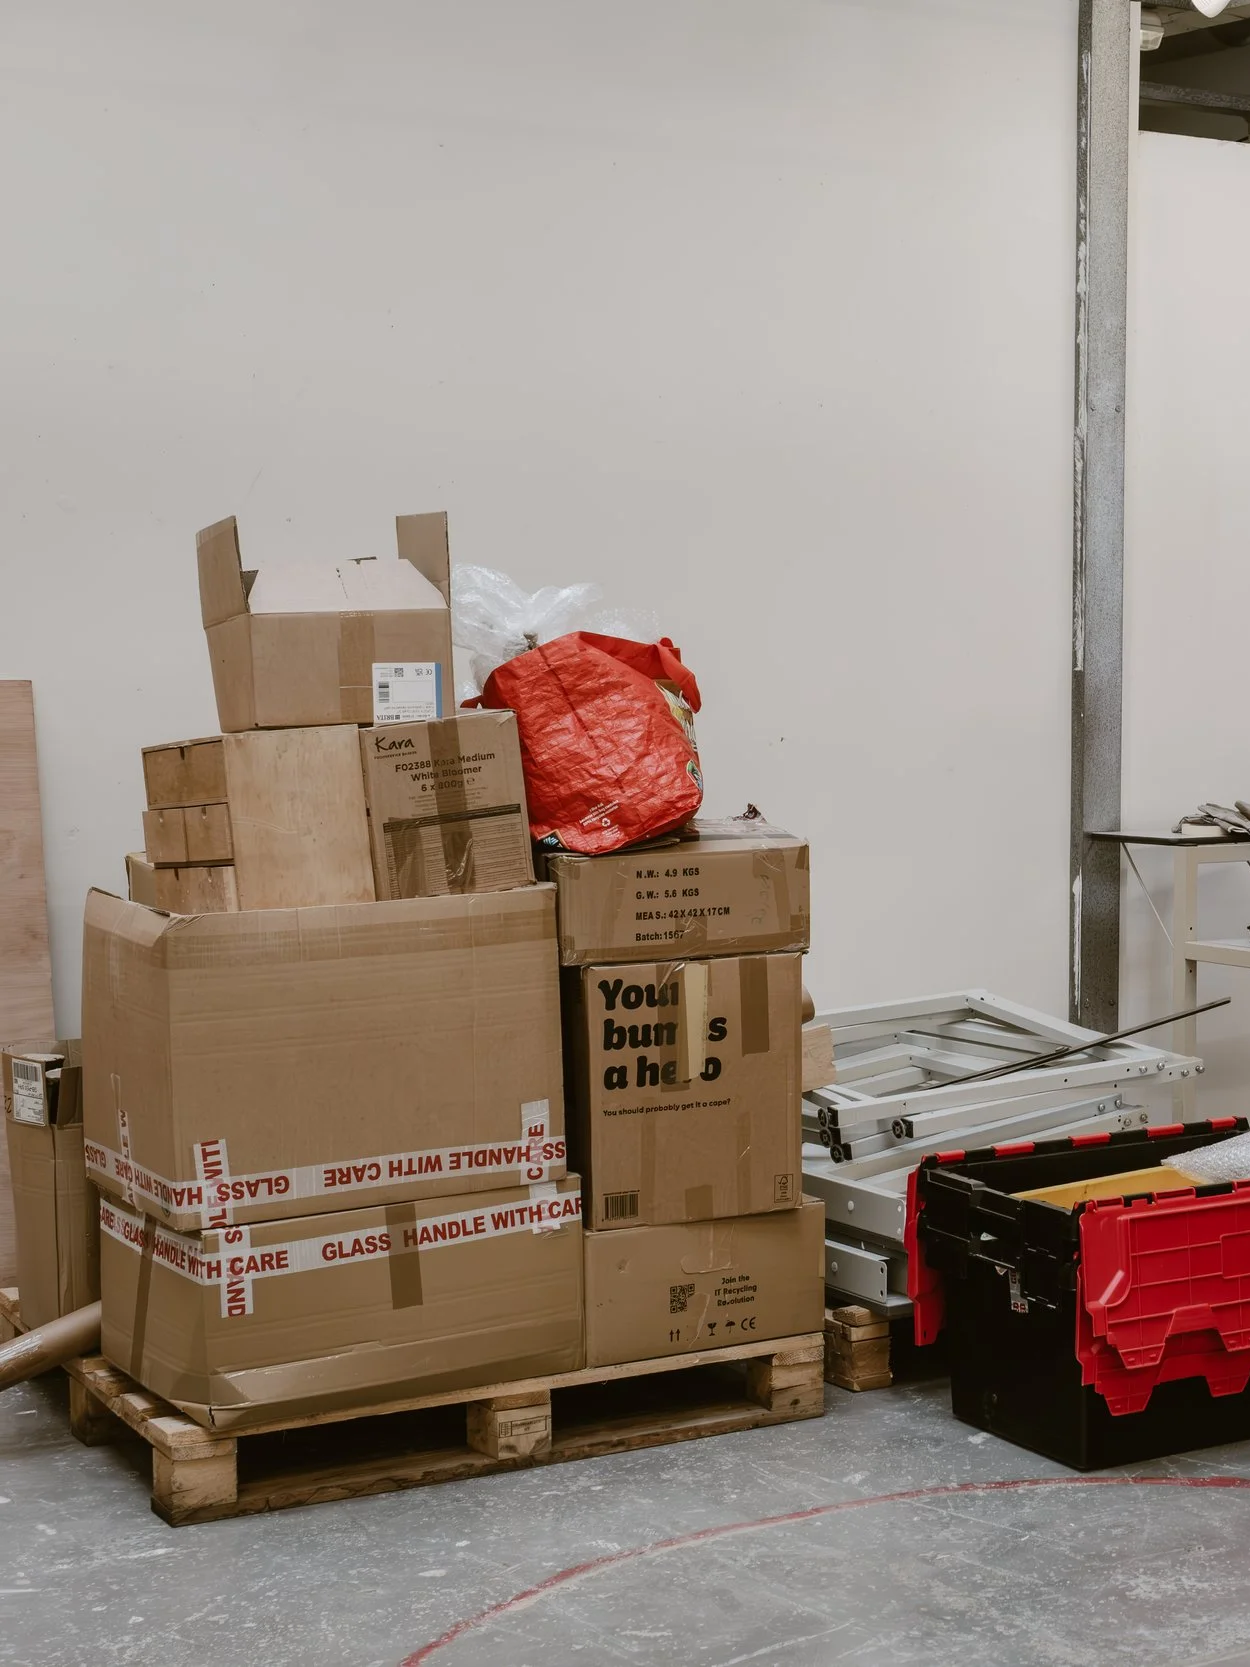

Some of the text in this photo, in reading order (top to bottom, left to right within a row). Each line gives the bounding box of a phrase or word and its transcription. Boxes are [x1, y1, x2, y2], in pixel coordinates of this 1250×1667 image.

[374, 736, 415, 753] Kara
[433, 757, 455, 768] Kara
[458, 751, 496, 764] Medium
[410, 765, 482, 782] White Bloomer
[421, 782, 428, 792] 6
[430, 783, 436, 791] x
[664, 868, 678, 878] 4.9
[682, 867, 700, 876] KGS
[664, 889, 677, 898] 5.6
[682, 888, 700, 897] KGS
[604, 1055, 722, 1090] a heo
[602, 1109, 617, 1117] You
[618, 1106, 644, 1116] should
[645, 1103, 680, 1114] probably
[681, 1102, 694, 1111] get
[695, 1100, 702, 1108] it
[708, 1098, 731, 1108] cape?
[85, 1144, 106, 1169] GLASS
[388, 1154, 443, 1178] WITH
[449, 1145, 530, 1171] HANDLE
[114, 1158, 133, 1182] CARE
[134, 1168, 153, 1193] WITH
[323, 1162, 382, 1188] CARE
[153, 1179, 203, 1207] HANDLE
[216, 1175, 290, 1202] GLASS
[100, 1206, 116, 1230] ARE
[152, 1236, 186, 1271] HANDLE
[187, 1256, 222, 1280] WITH
[229, 1250, 289, 1276] CARE
[322, 1232, 392, 1262] GLASS
[403, 1215, 486, 1248] HANDLE
[490, 1204, 543, 1232] WITH
[714, 1284, 757, 1296] IT Recycling
[721, 1274, 750, 1285] Join the
